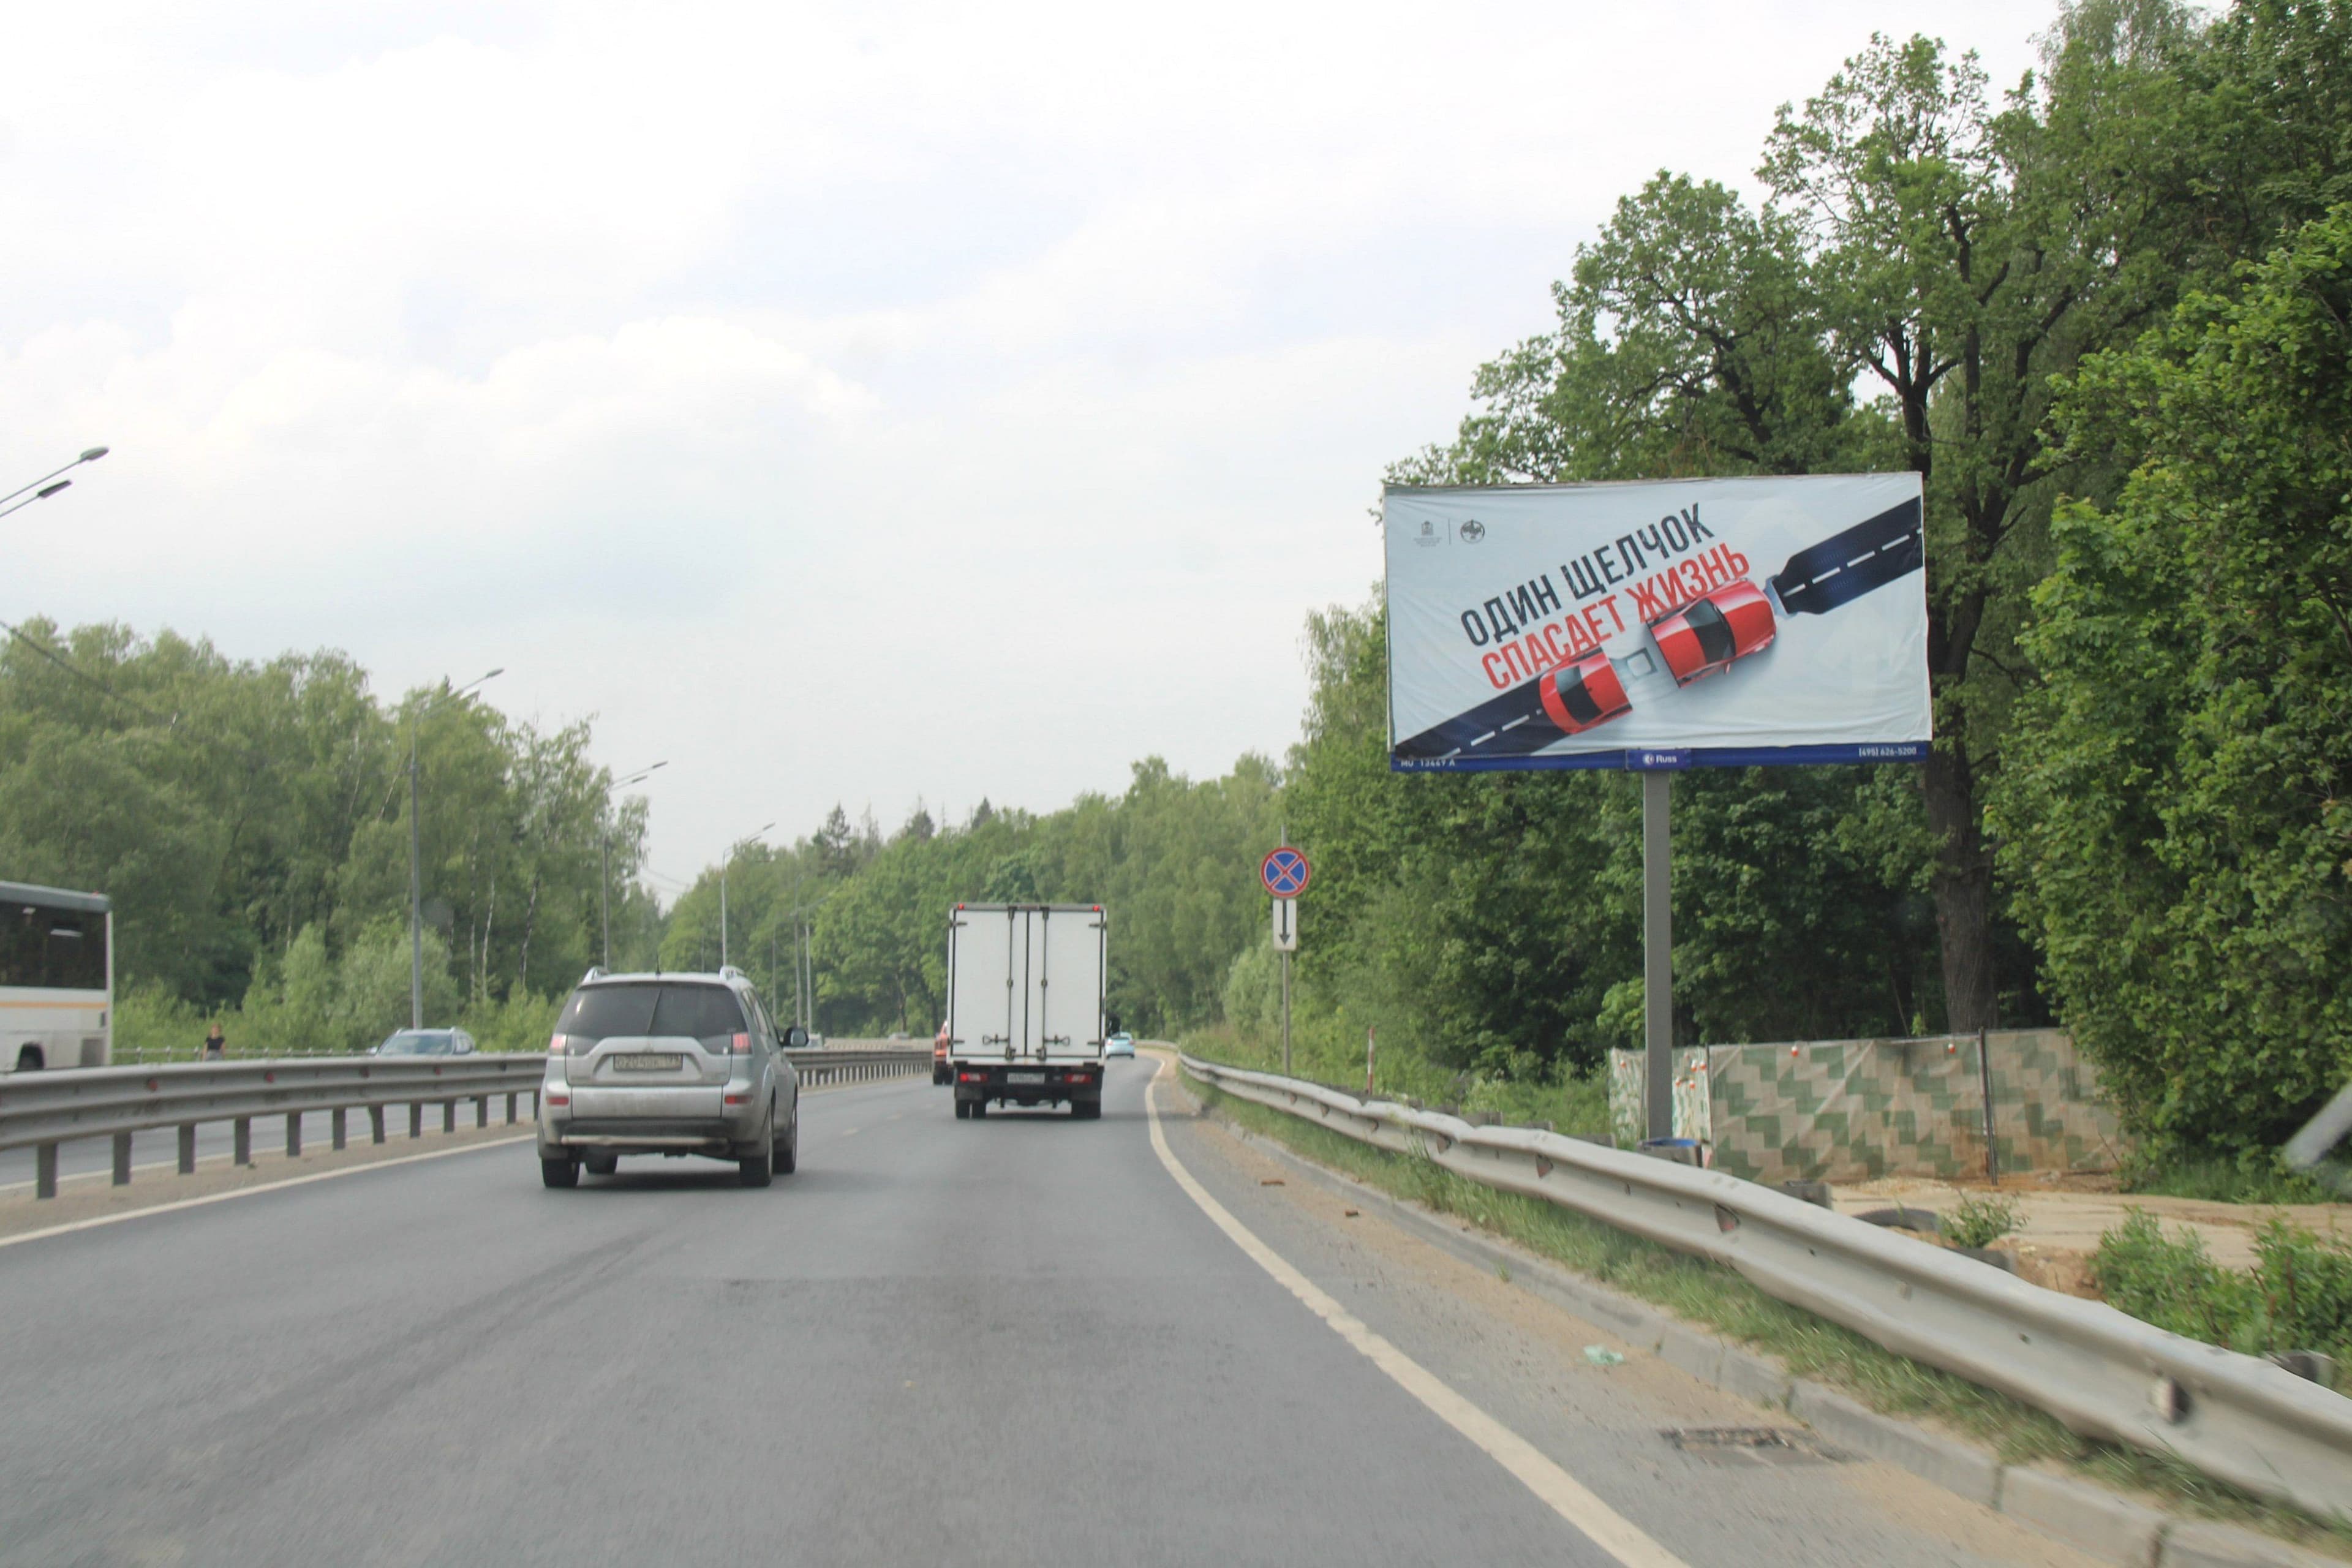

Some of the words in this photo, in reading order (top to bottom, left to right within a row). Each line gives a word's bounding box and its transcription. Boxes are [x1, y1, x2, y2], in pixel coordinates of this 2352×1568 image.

[1460, 574, 1562, 647] ОДИН
[1560, 502, 1715, 601] ЩЕЛЧОК
[1481, 594, 1626, 690] СПАСАЕТ
[1624, 542, 1750, 624] ЖИЗНЬ
[1656, 754, 1677, 764] Russ
